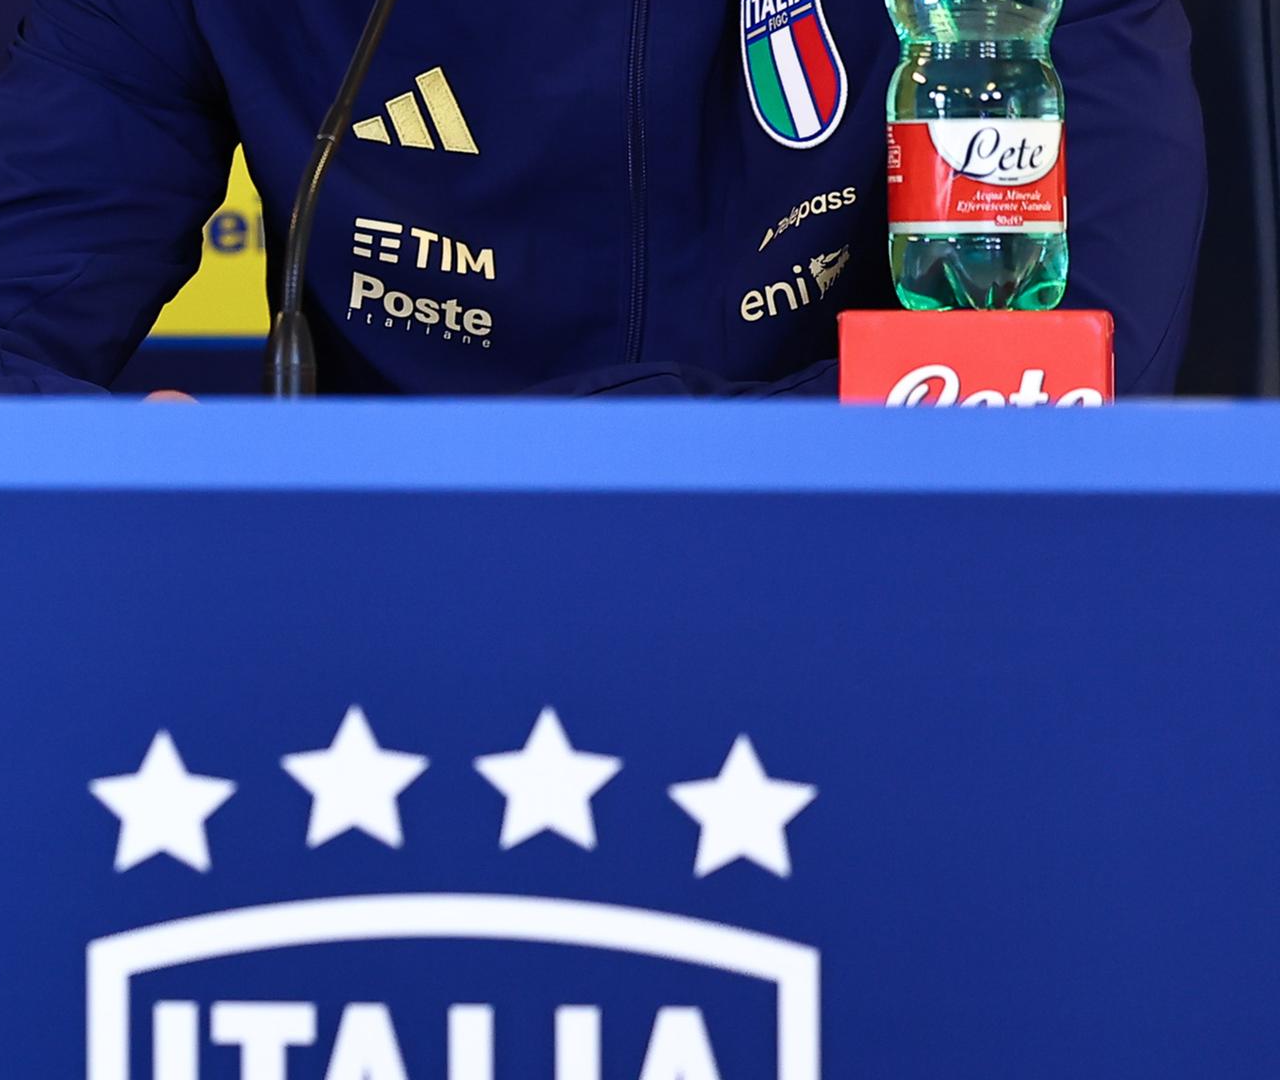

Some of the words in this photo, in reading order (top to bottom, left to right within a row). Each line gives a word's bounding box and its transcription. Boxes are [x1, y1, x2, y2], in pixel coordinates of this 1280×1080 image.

[768, 11, 788, 32] FIGC
[952, 126, 1044, 180] Lete
[410, 227, 496, 280] TIM
[349, 271, 493, 336] Poste
[740, 264, 810, 322] eni
[346, 308, 492, 349] italiane
